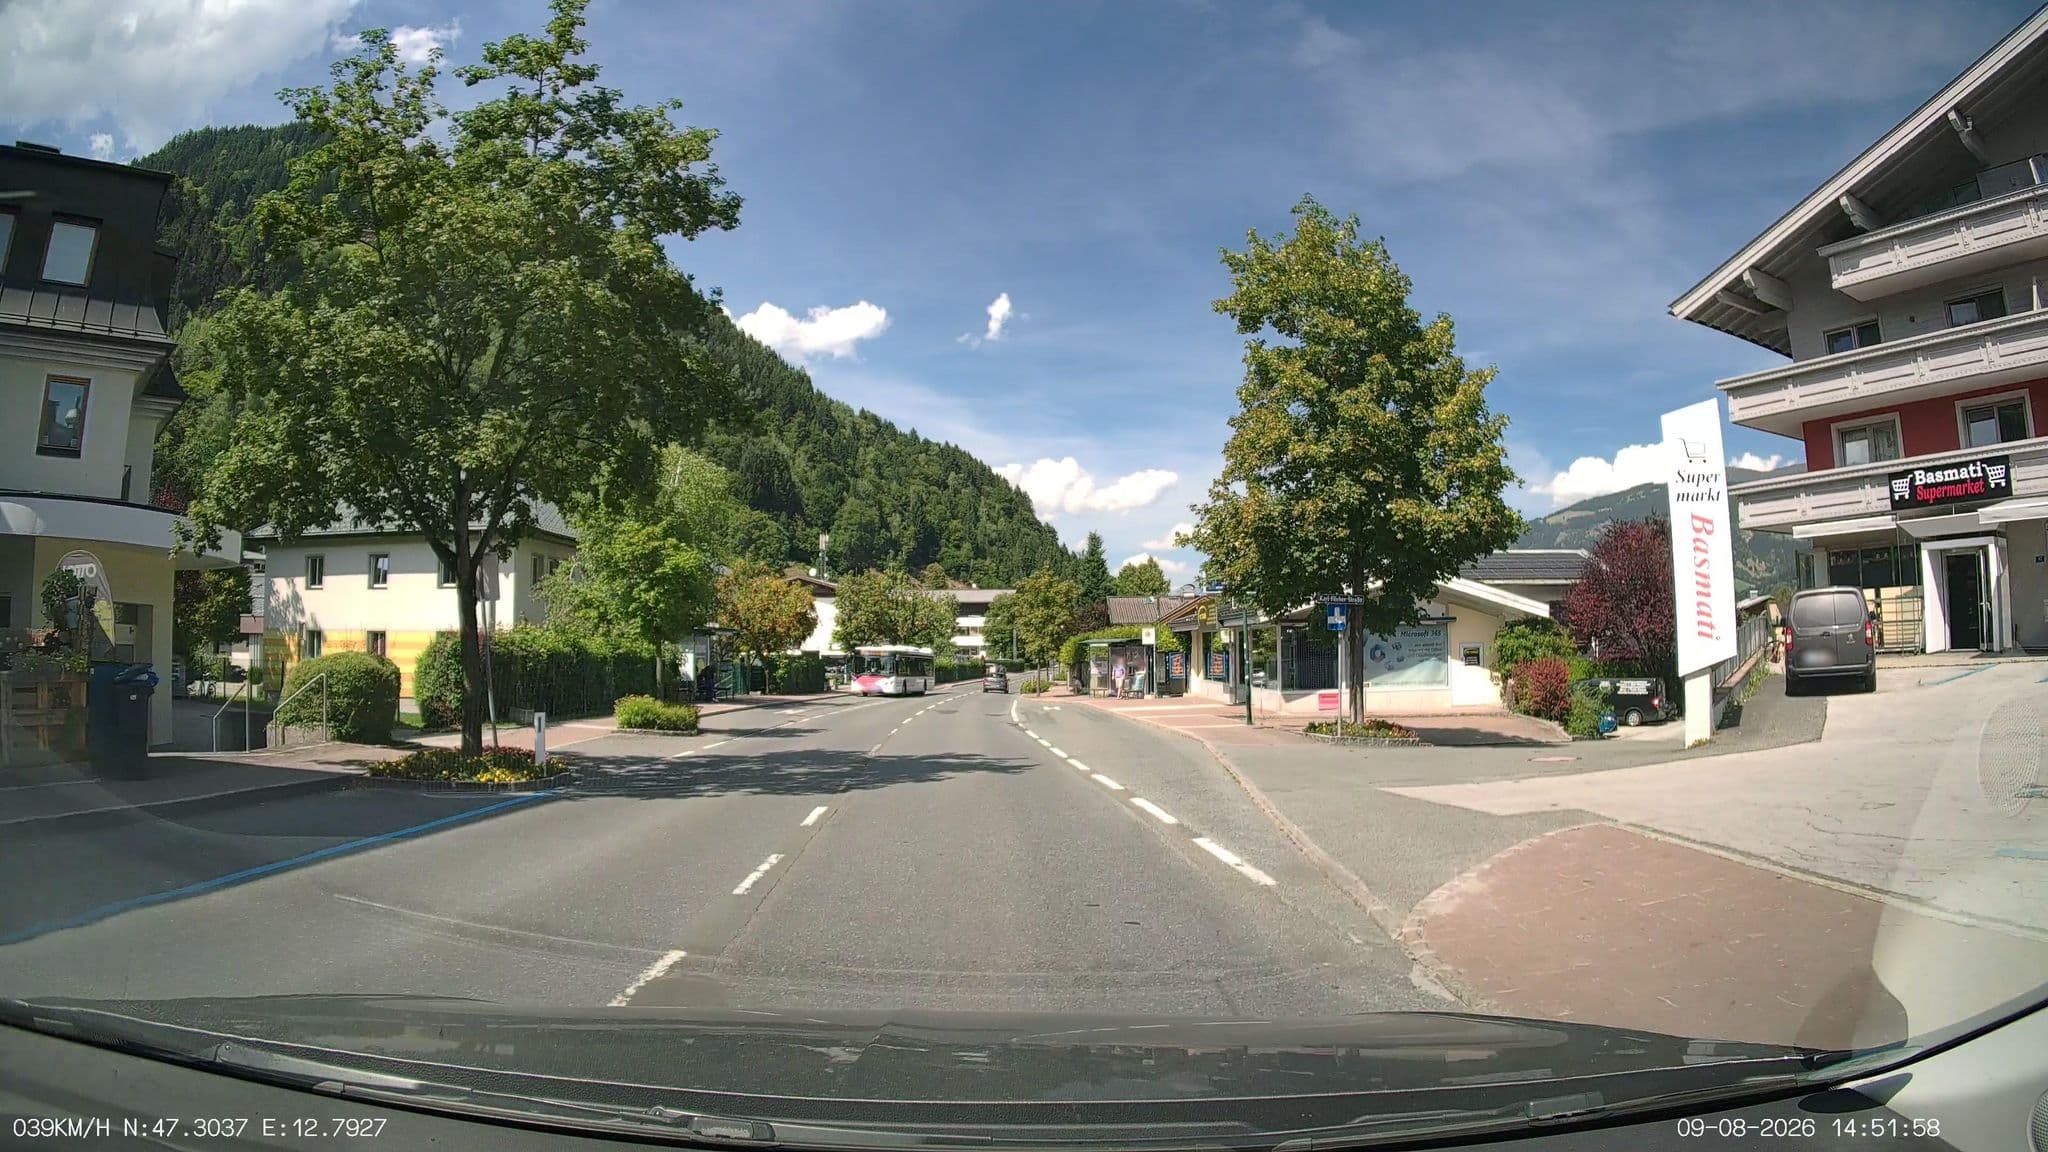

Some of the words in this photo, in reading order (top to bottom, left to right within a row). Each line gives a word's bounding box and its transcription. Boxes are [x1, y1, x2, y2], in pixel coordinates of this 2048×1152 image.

[1675, 469, 1721, 486] Super
[1914, 461, 1984, 486] Basmati
[1676, 487, 1721, 503] markt
[1916, 477, 1985, 504] Supermarket
[1690, 512, 1716, 640] Basmati
[1400, 630, 1429, 638] Microsoft
